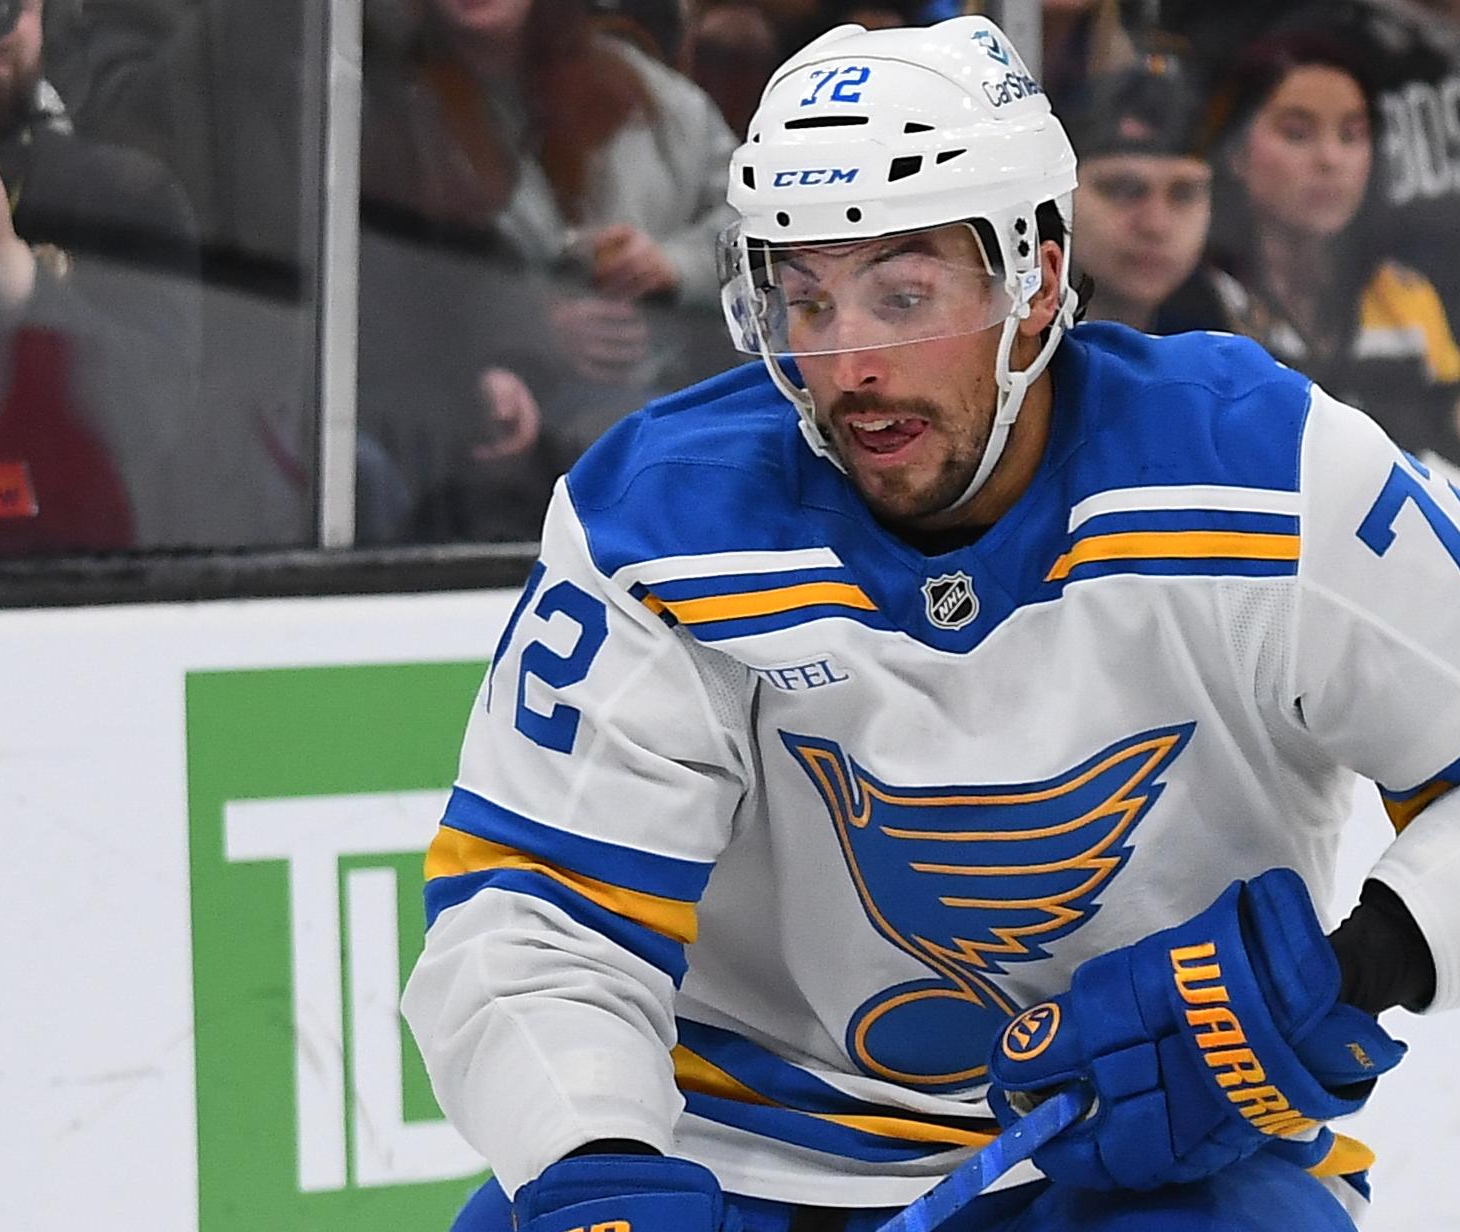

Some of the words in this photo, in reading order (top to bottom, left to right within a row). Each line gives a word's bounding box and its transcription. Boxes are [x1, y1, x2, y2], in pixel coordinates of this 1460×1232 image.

[799, 66, 871, 107] 72
[773, 168, 859, 187] CCM
[938, 586, 965, 619] NHL
